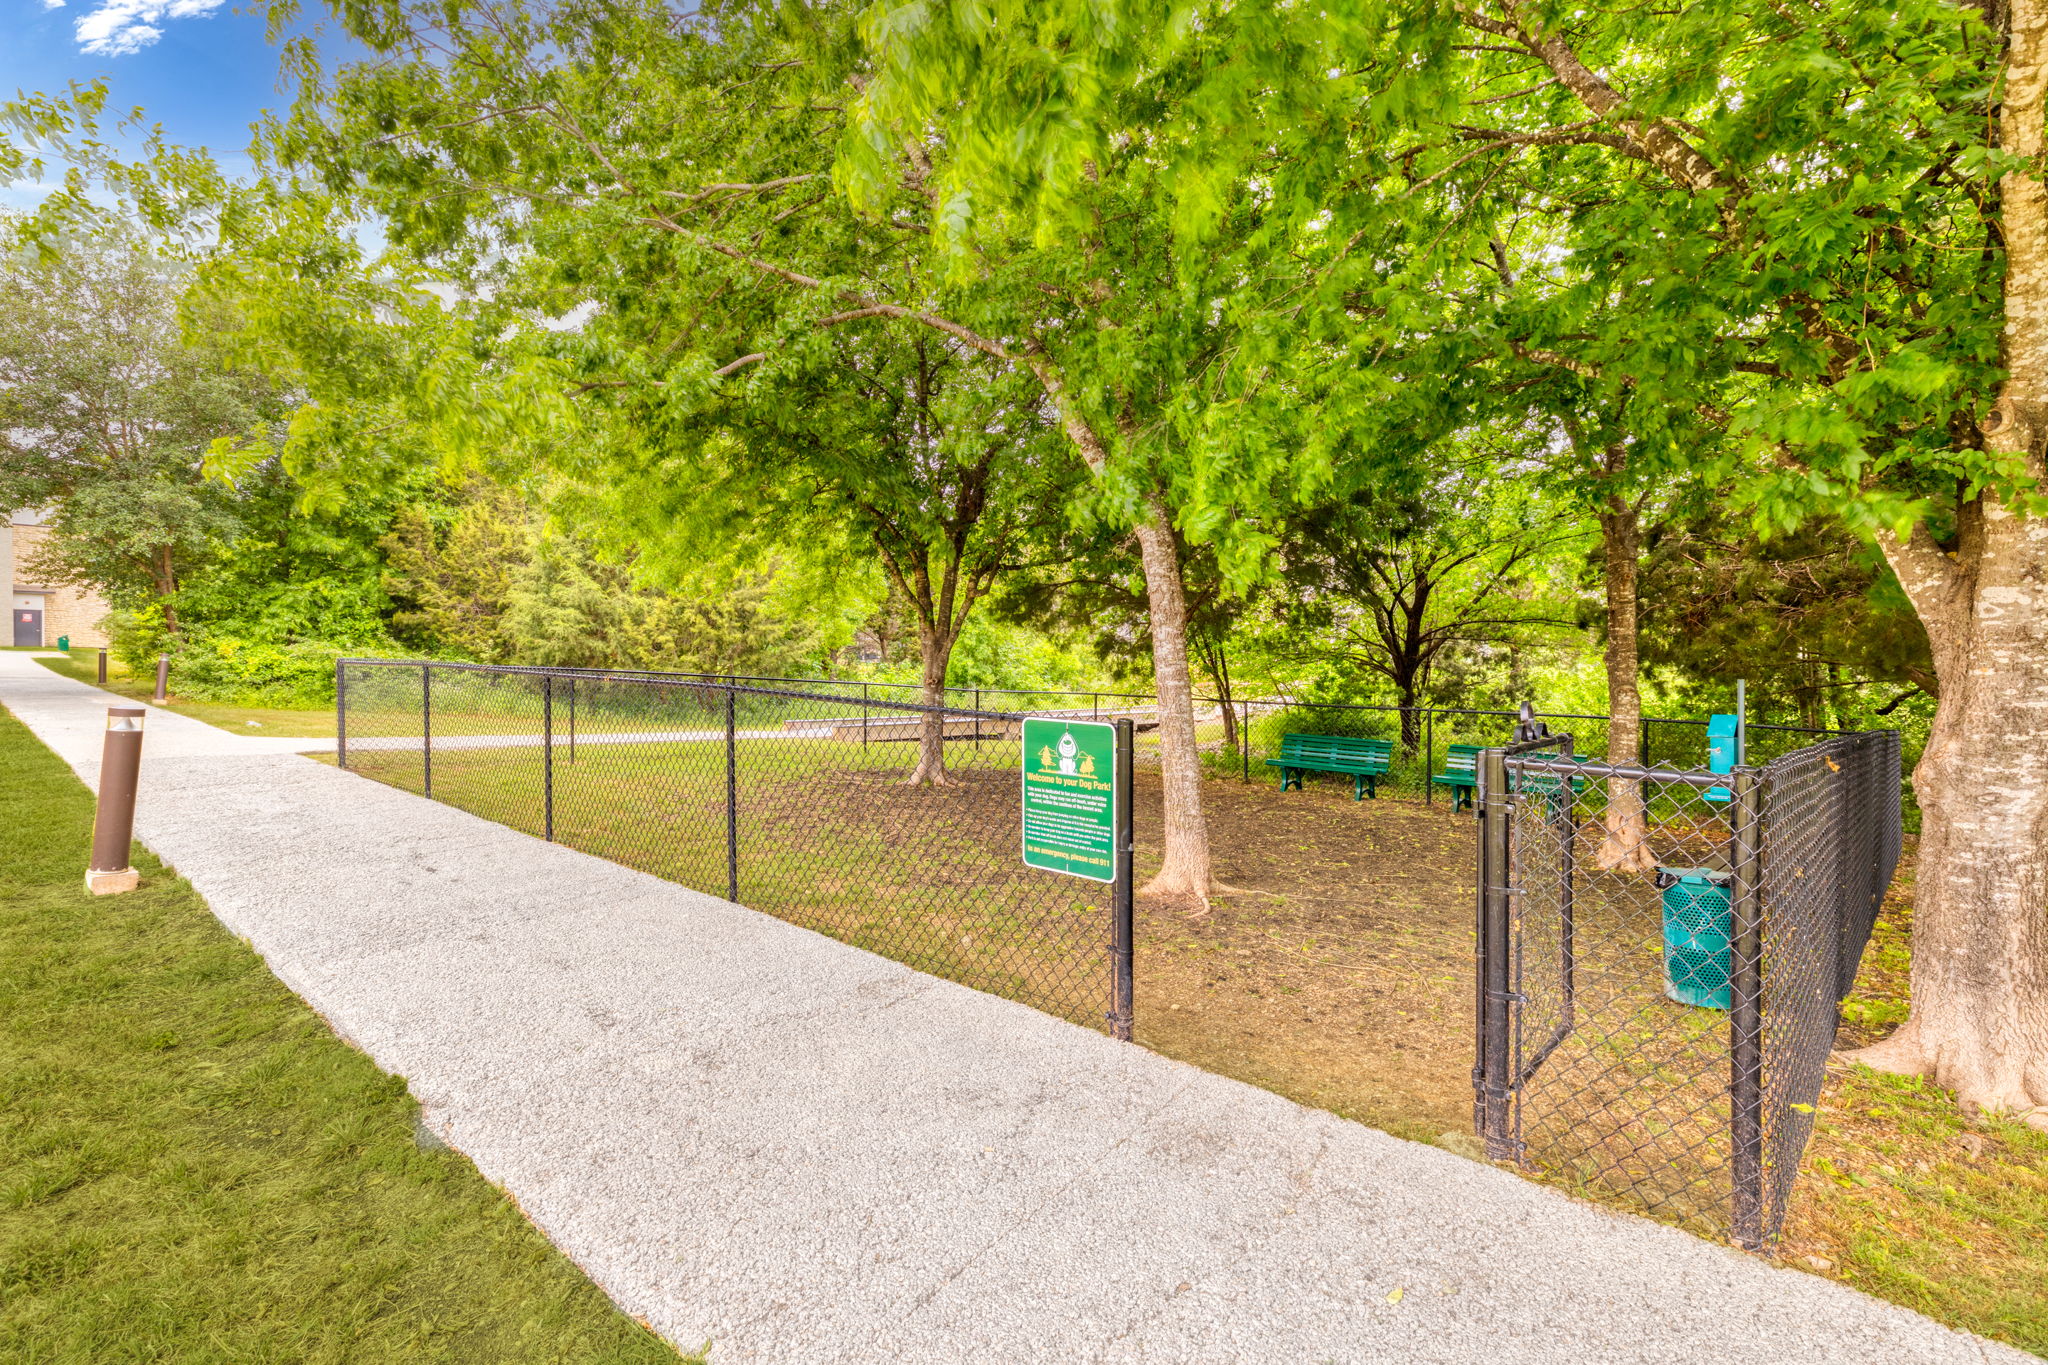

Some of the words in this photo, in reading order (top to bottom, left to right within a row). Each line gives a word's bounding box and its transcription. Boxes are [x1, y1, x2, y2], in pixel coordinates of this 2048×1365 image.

[1027, 772, 1054, 783] Welcome
[1056, 776, 1062, 784] to
[1064, 778, 1078, 787] your
[1079, 779, 1092, 790] Dog
[1093, 781, 1111, 791] Park!
[1041, 848, 1070, 860] emergency,
[1071, 853, 1088, 862] please
[1089, 857, 1099, 865] call
[1100, 858, 1110, 867] 911
